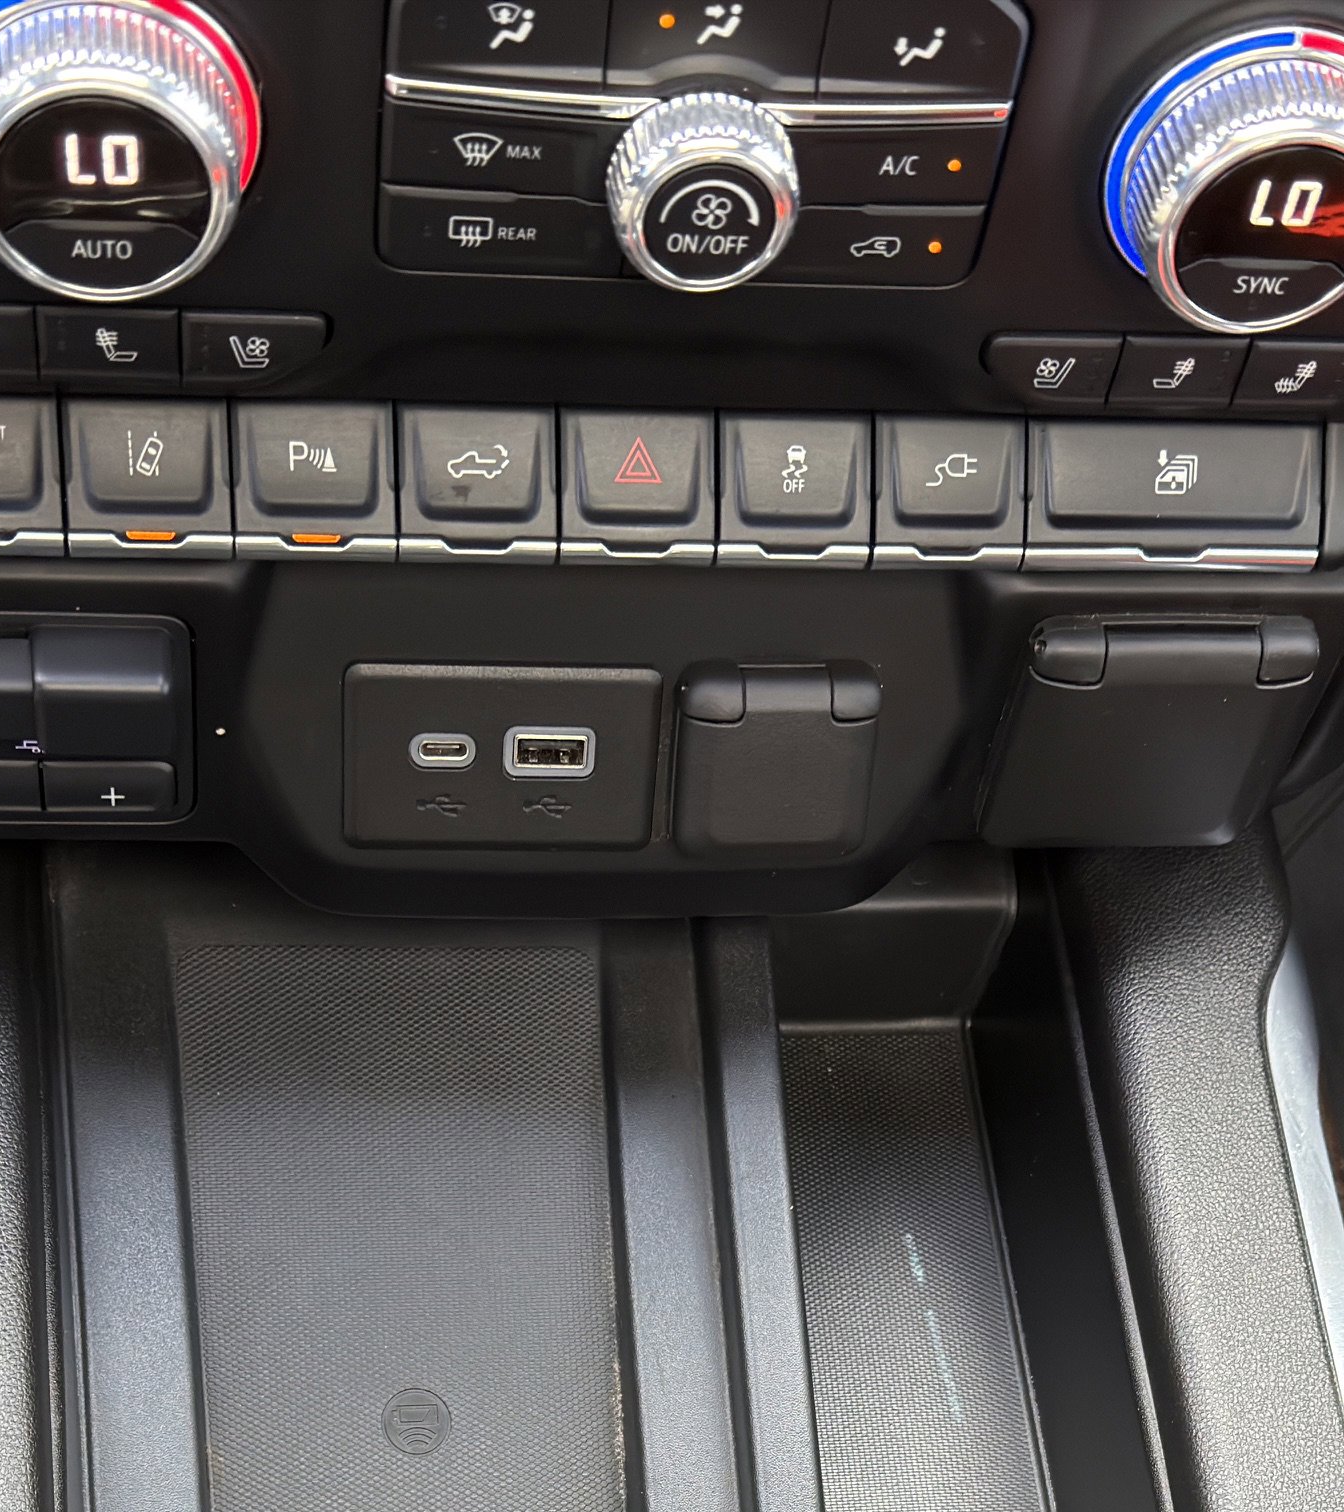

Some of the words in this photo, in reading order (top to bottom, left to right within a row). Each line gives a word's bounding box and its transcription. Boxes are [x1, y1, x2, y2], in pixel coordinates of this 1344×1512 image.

[65, 133, 140, 186] LO
[506, 144, 542, 160] MAX
[879, 155, 919, 176] A/C
[1249, 178, 1324, 227] LO
[497, 226, 537, 241] REAR
[666, 232, 750, 256] ON/OFF
[71, 239, 133, 260] AUTO
[1233, 275, 1290, 295] SYNC
[782, 478, 806, 494] OFF
